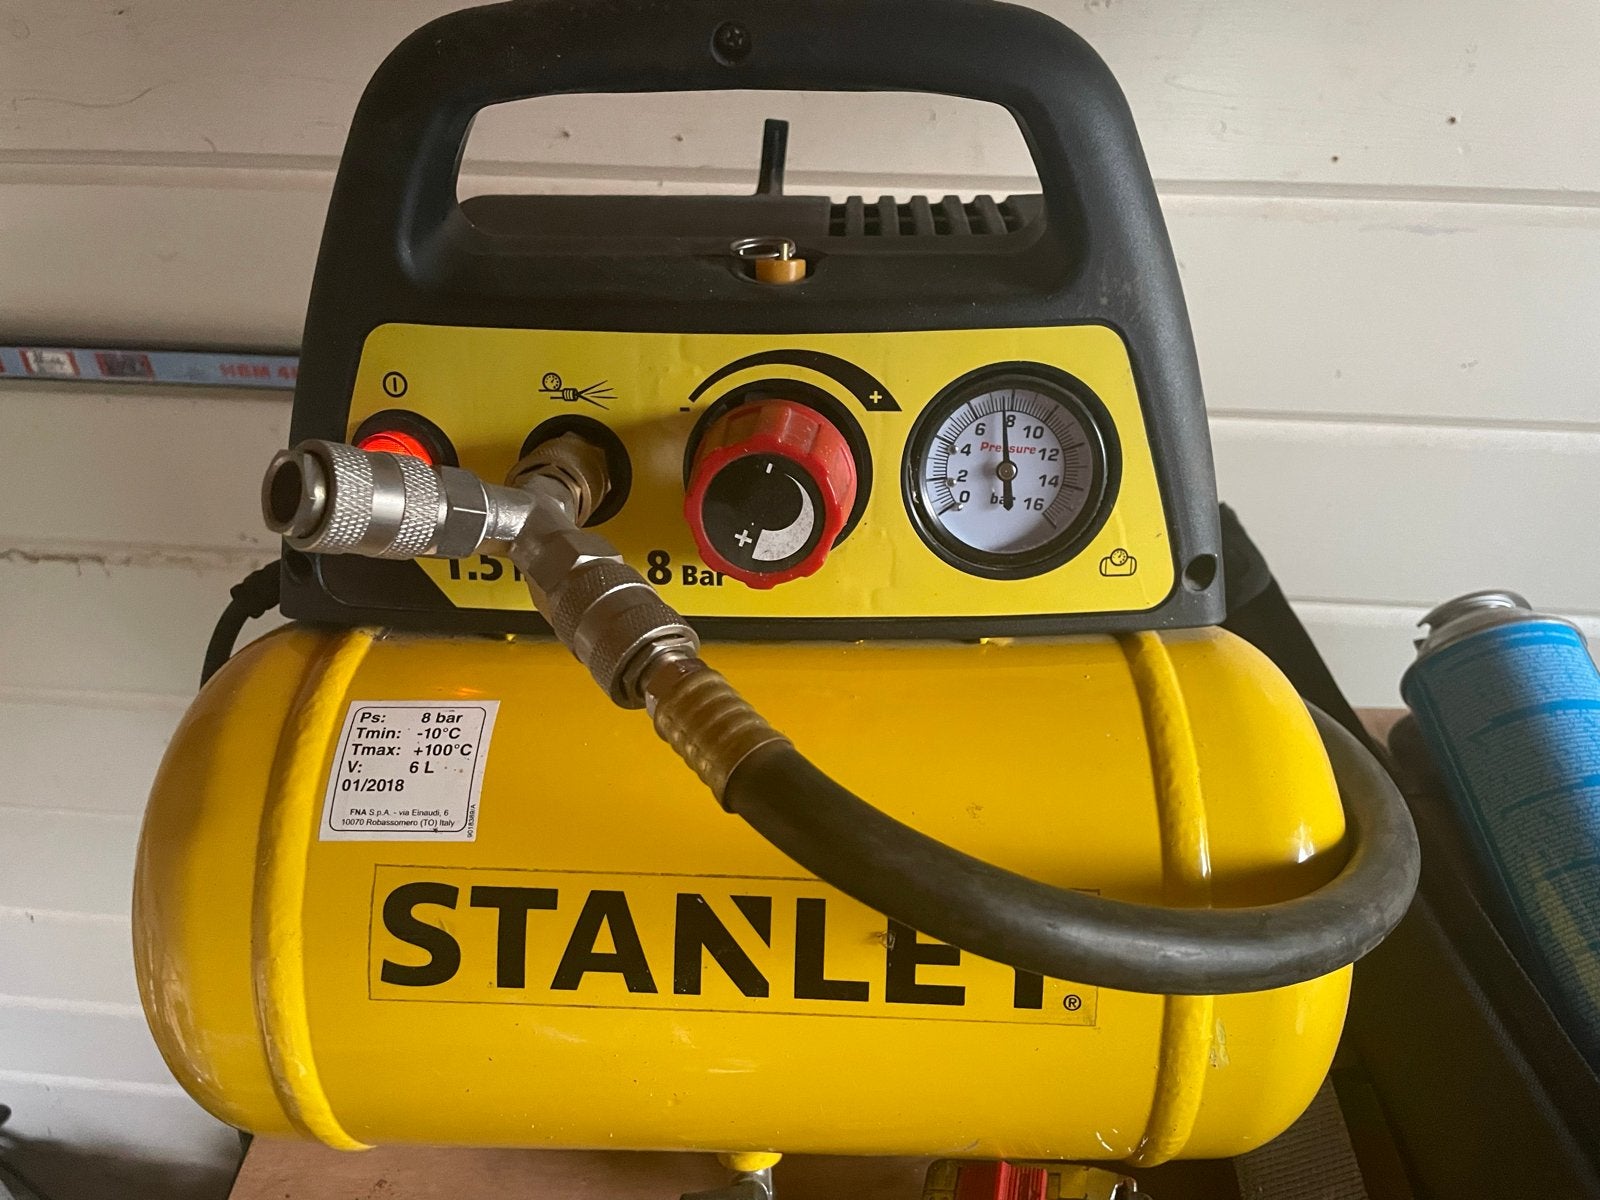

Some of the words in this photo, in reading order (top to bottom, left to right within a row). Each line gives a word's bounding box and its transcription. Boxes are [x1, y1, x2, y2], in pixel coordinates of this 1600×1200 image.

[1006, 414, 1016, 428] 8
[975, 422, 986, 436] 6
[1023, 425, 1045, 439] 10
[960, 443, 971, 456] 4
[980, 441, 1037, 455] Presure
[1038, 447, 1060, 462] 12
[957, 469, 968, 482] 2
[1038, 474, 1060, 488] 14
[959, 490, 970, 503] 0
[1023, 497, 1045, 511] 16
[647, 549, 673, 586] 8
[682, 564, 726, 587] Bar
[360, 712, 387, 723] Ps:
[421, 712, 432, 724] 8
[436, 712, 463, 723] bar
[356, 727, 402, 739] Tmin:
[417, 727, 461, 740] -10°C
[352, 743, 402, 756] Tmax:
[413, 743, 473, 756] +100°C
[348, 760, 363, 773] V:
[409, 761, 420, 774] 6
[424, 761, 435, 774] L
[341, 778, 405, 792] 01/2018
[349, 808, 367, 816] FNA
[398, 809, 410, 817] via
[443, 809, 449, 817] 6
[341, 818, 364, 826] 10070
[366, 819, 418, 827] Robassomero
[420, 819, 438, 828] (TO)
[439, 819, 456, 828] Italy
